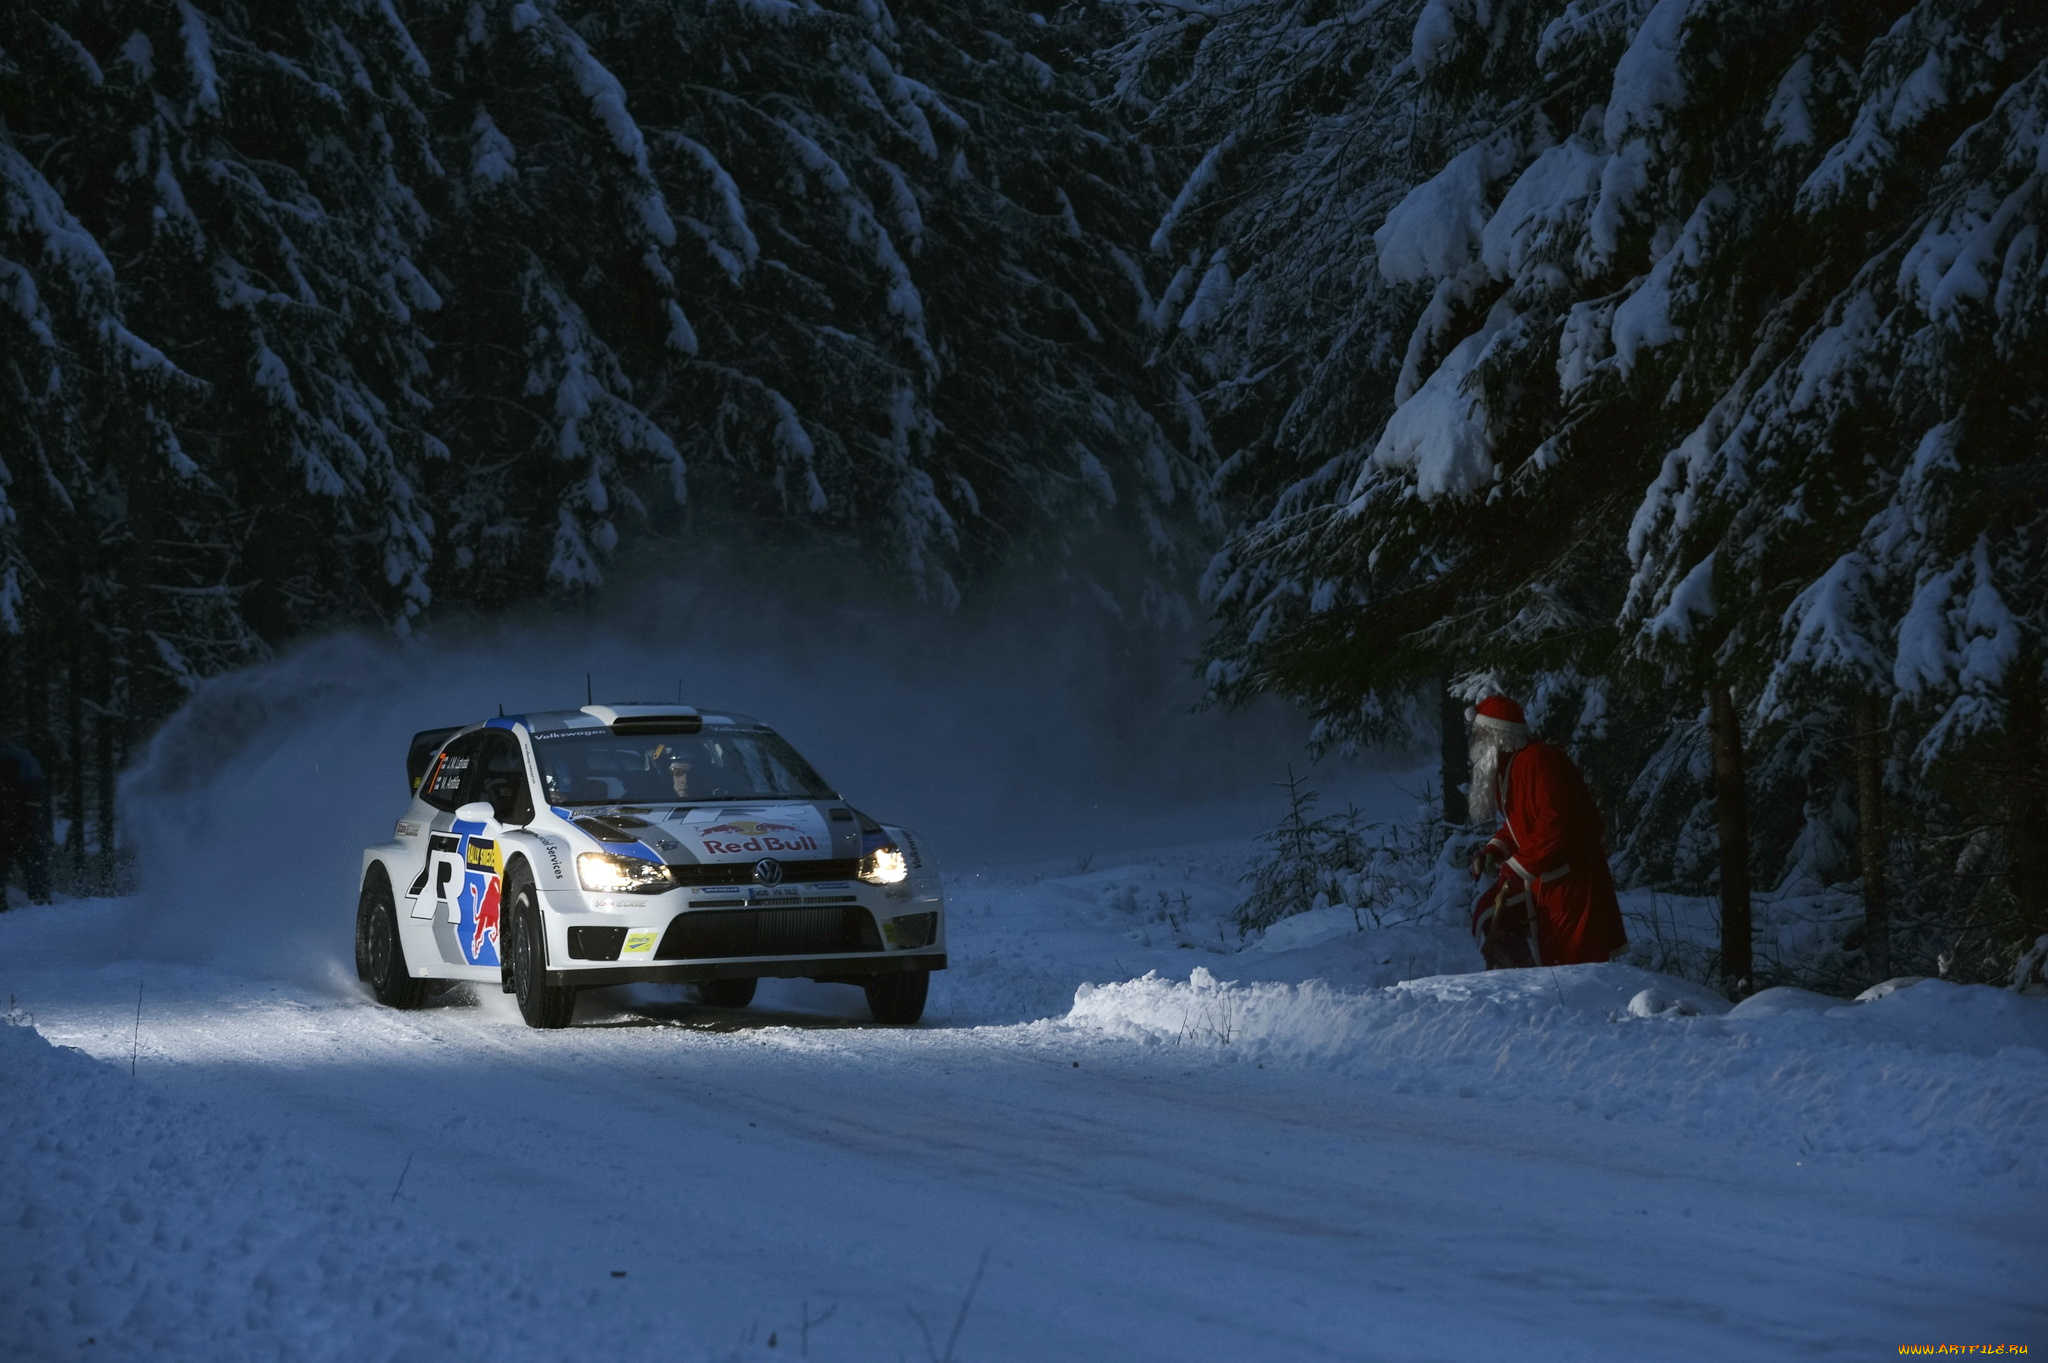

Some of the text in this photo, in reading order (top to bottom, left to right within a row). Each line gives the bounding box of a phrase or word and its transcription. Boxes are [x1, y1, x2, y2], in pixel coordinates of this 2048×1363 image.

[534, 730, 606, 741] Volkswagen
[467, 842, 481, 863] RALLY
[703, 836, 818, 855] Red Bull
[546, 846, 563, 880] Services
[616, 899, 648, 908] EDGE
